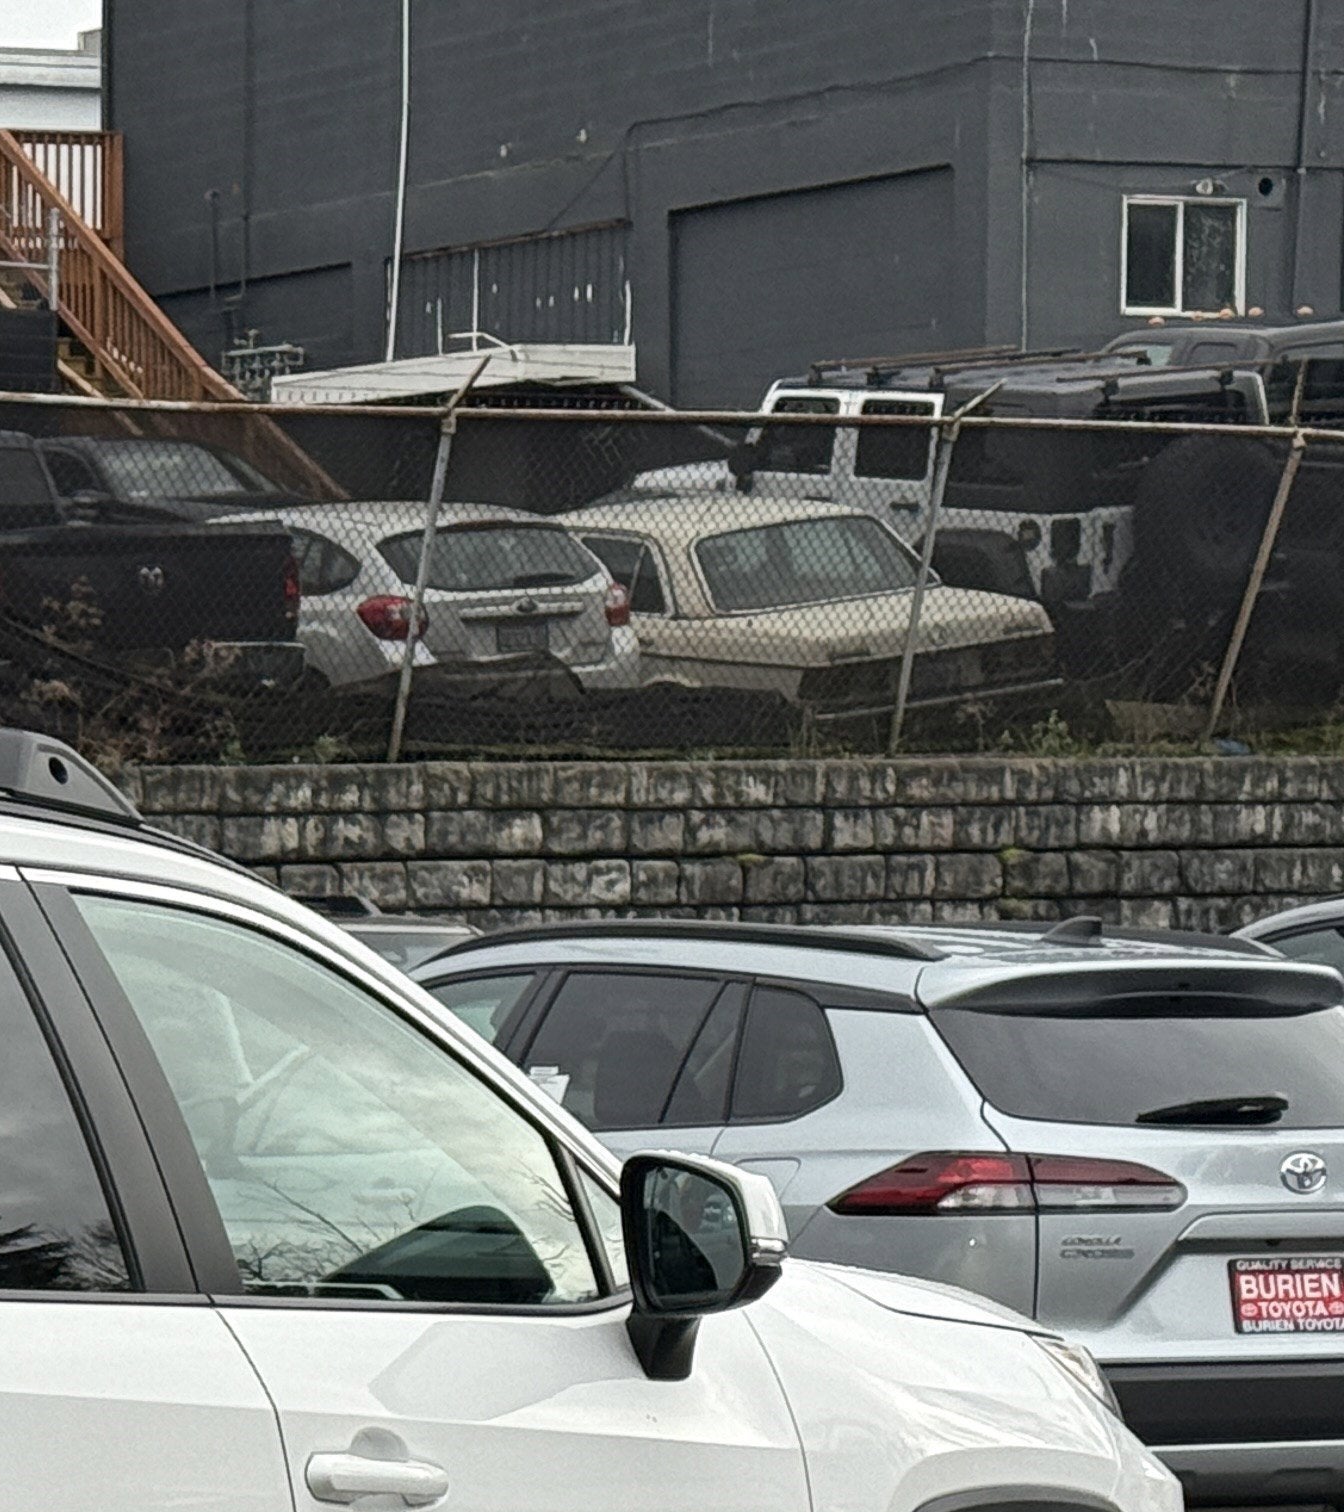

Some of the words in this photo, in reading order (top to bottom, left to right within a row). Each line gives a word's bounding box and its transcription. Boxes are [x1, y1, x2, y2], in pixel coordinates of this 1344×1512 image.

[1236, 1259, 1289, 1271] QUALITY
[1290, 1258, 1343, 1270] SERVICE
[1239, 1273, 1342, 1299] BURIEN
[1257, 1301, 1330, 1318] TOYOTA
[1242, 1319, 1295, 1332] BURIEN
